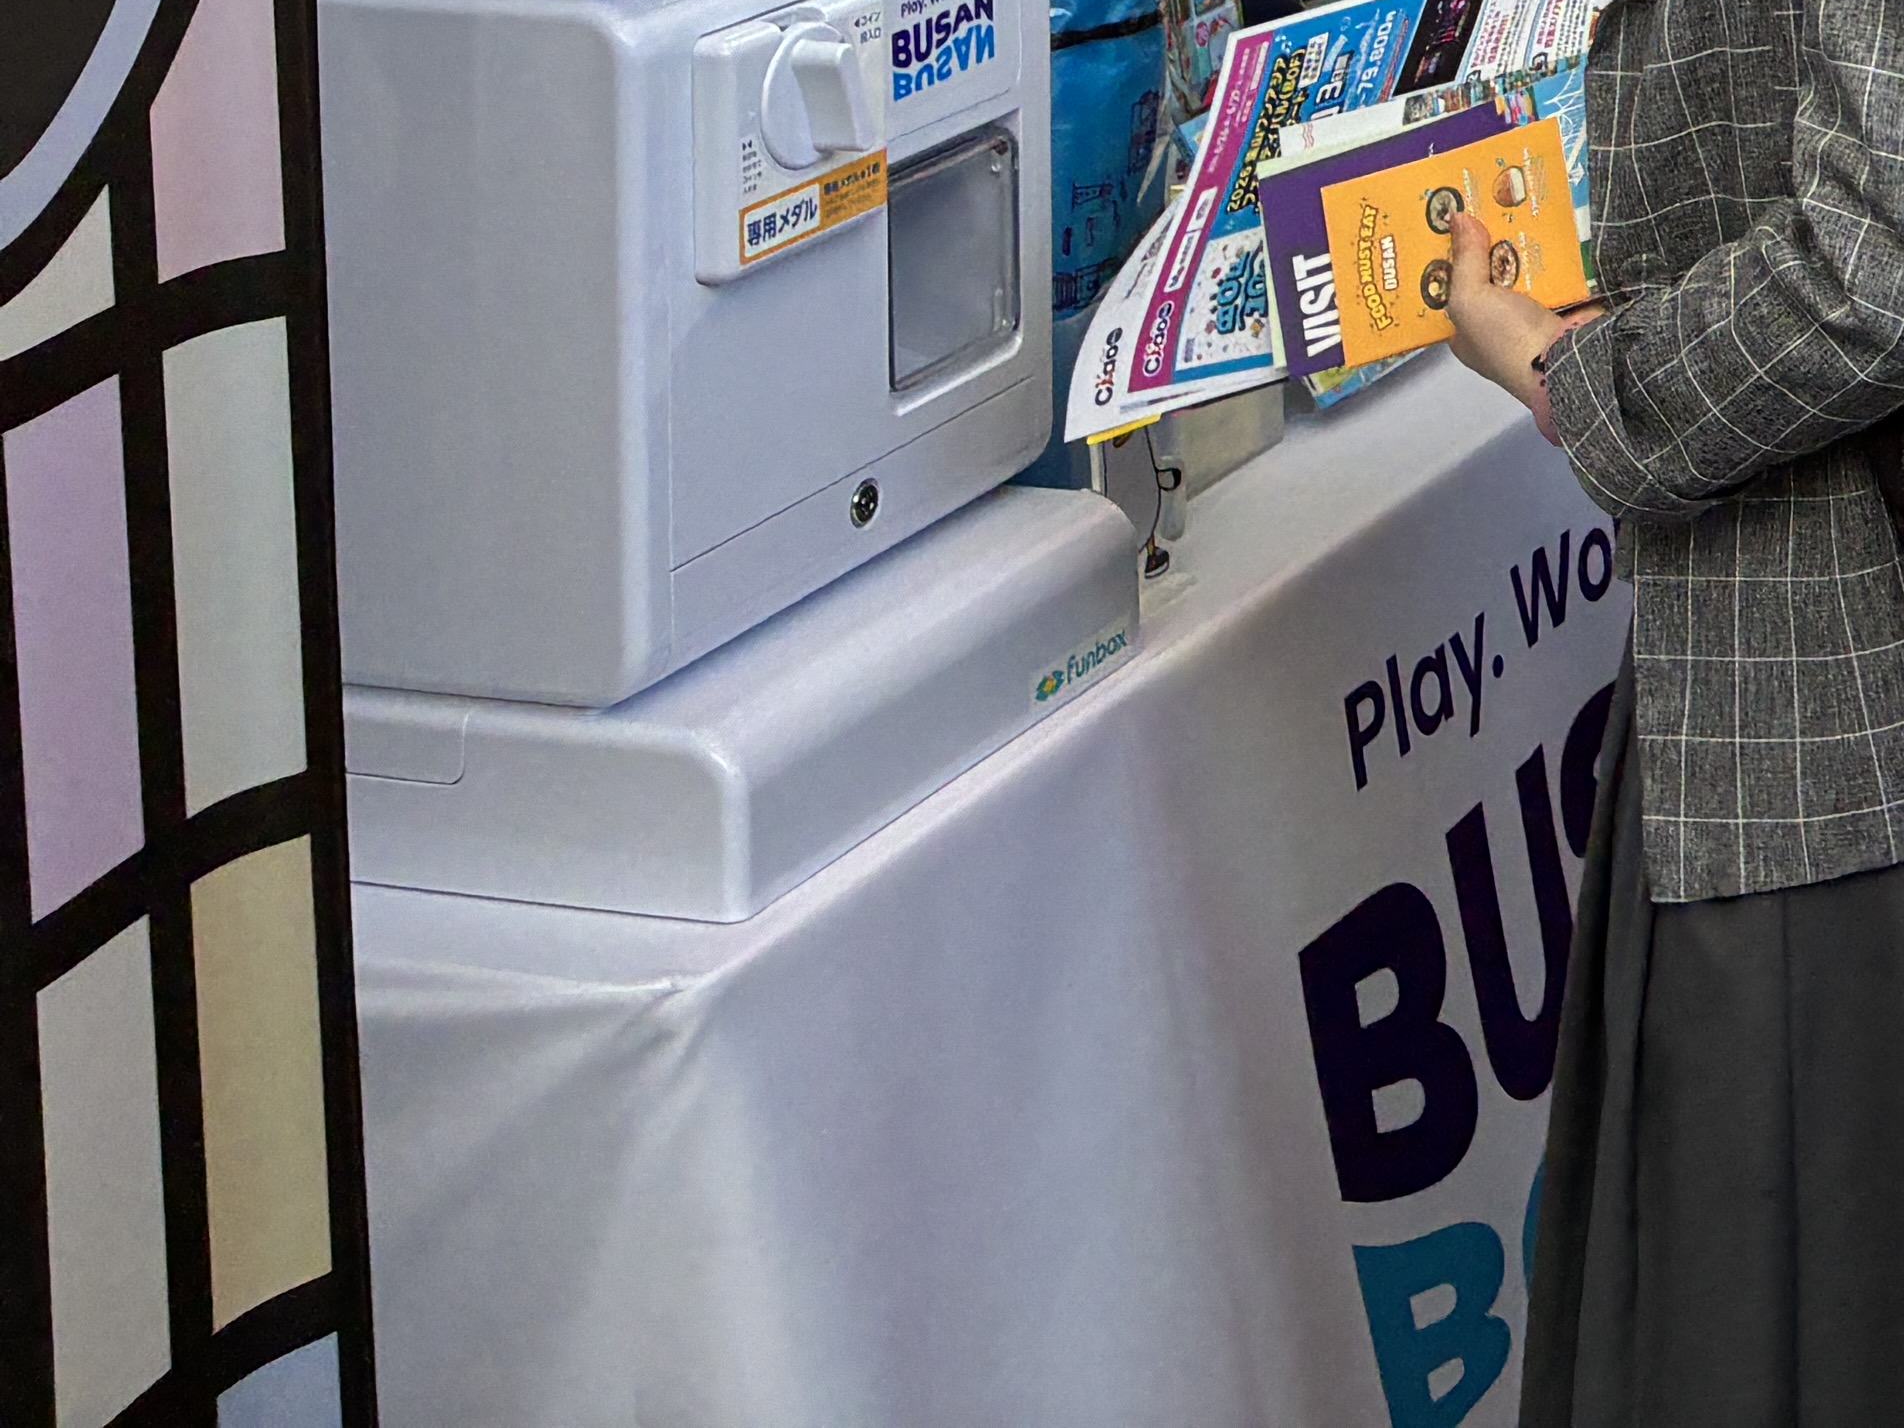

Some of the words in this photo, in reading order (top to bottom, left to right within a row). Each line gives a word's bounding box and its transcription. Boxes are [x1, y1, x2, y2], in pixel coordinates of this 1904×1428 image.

[746, 197, 818, 247] 専用メダル
[1360, 204, 1379, 238] EAT
[1356, 240, 1374, 283] MUST
[1291, 252, 1342, 358] VISIT
[1362, 283, 1393, 332] FOOD
[1066, 628, 1128, 685] funbox
[1343, 612, 1505, 792] Play.
